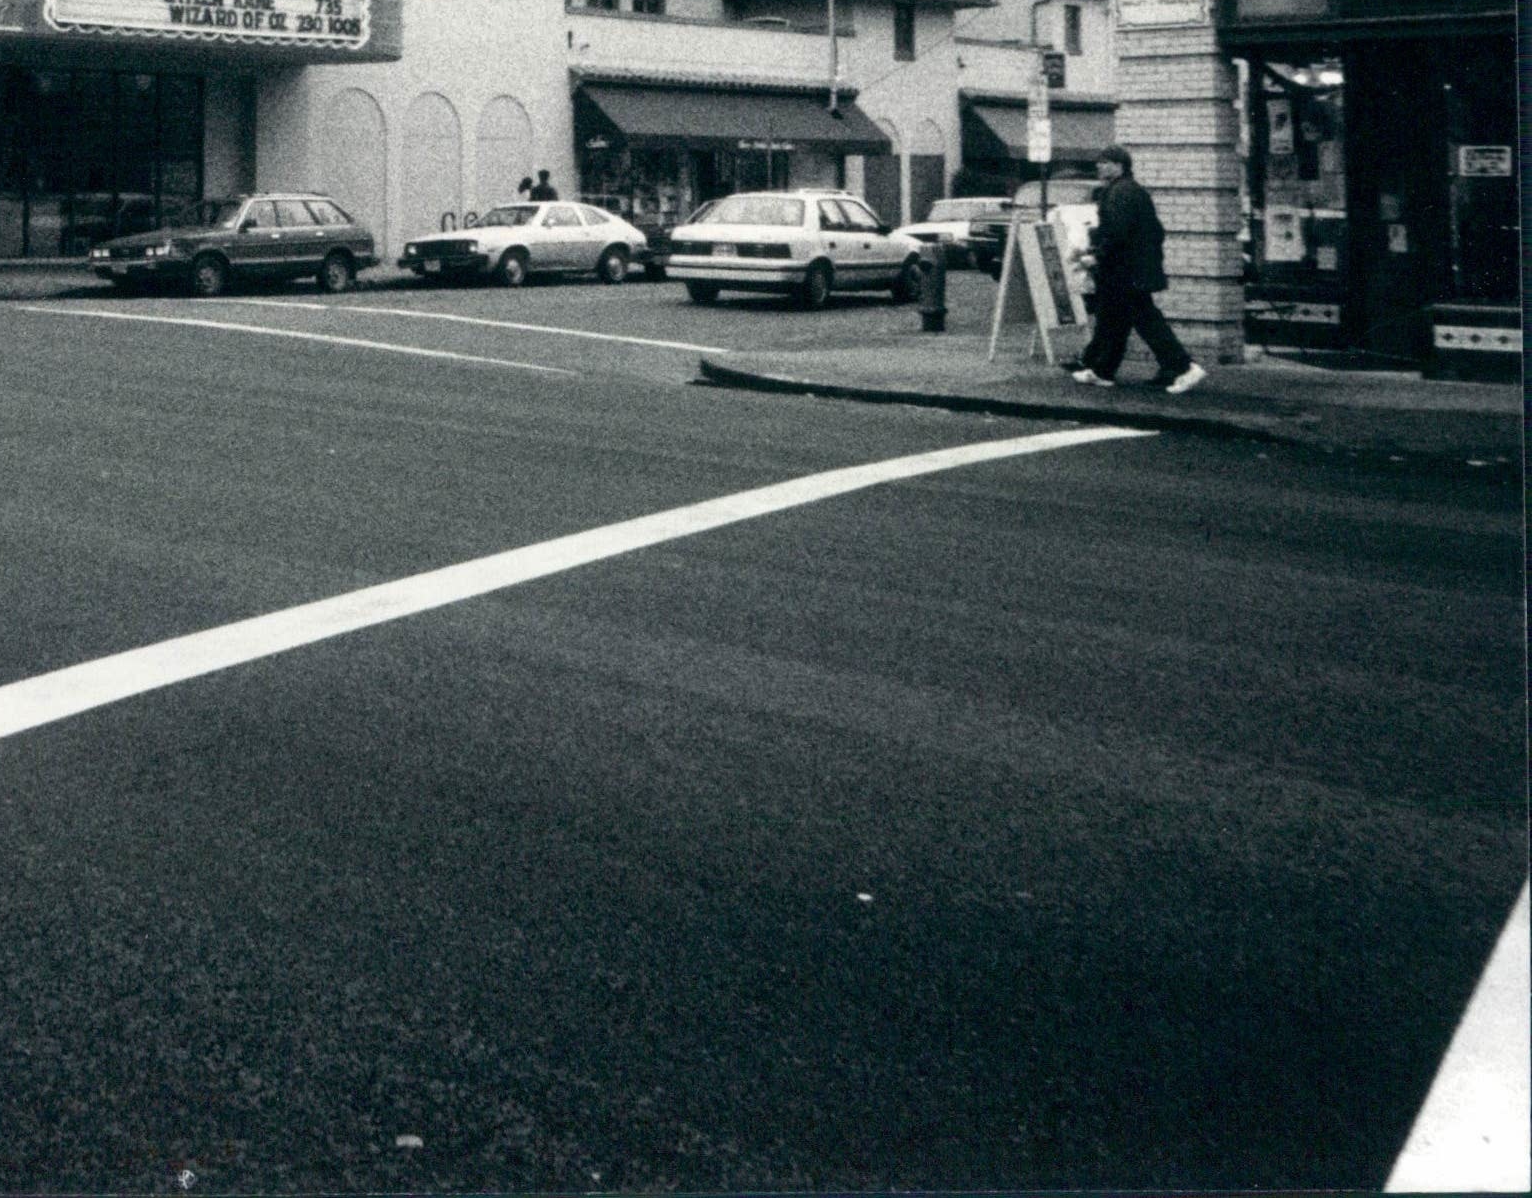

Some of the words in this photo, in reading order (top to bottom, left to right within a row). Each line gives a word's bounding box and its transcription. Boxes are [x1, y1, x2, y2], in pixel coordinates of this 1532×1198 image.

[170, 6, 238, 28] WIZARD
[242, 11, 266, 30] OF
[269, 12, 288, 31] OZ
